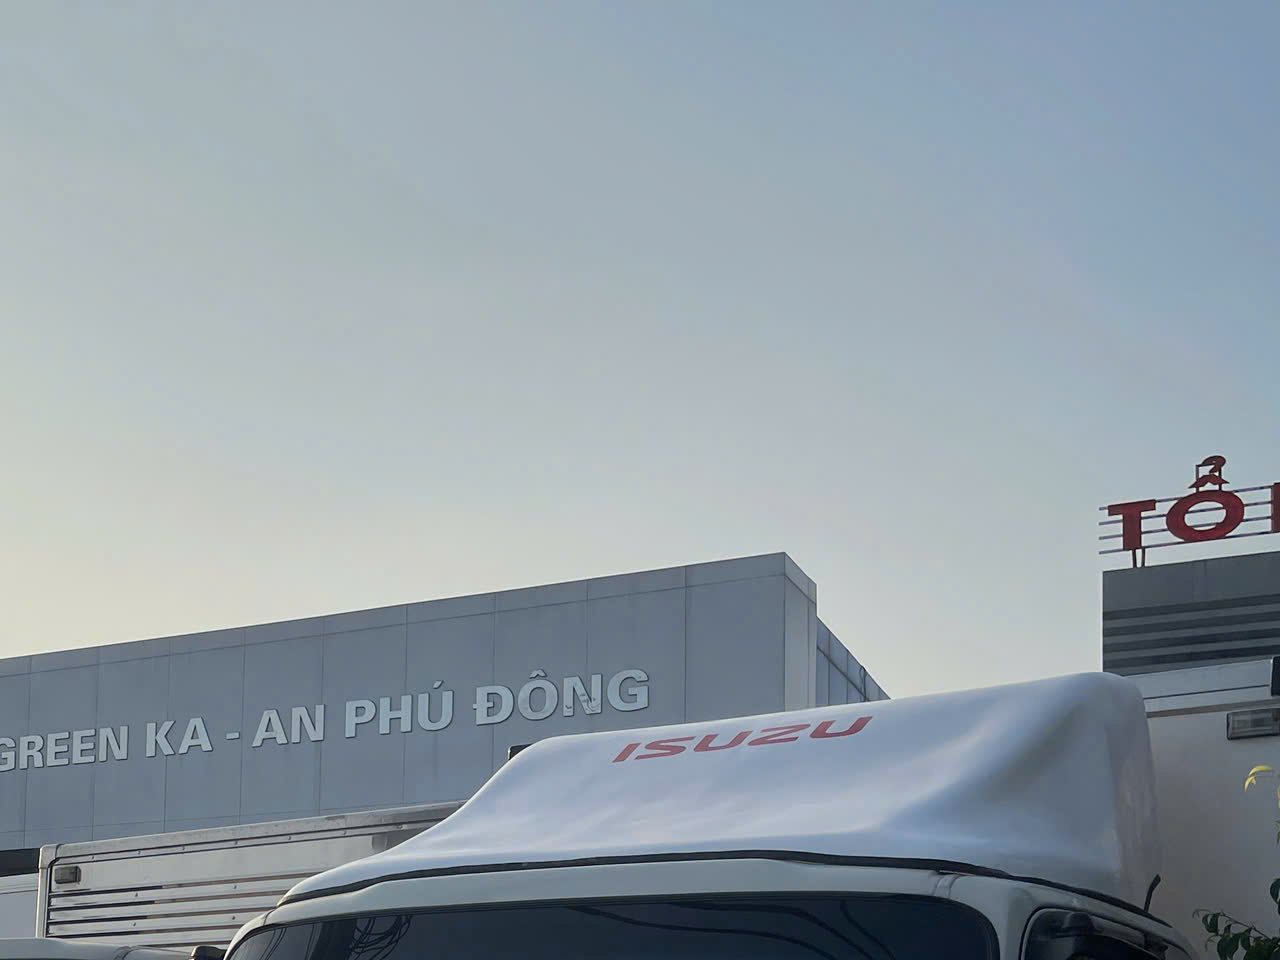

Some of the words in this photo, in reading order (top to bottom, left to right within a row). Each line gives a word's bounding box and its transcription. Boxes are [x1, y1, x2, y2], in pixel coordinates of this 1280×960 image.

[1107, 455, 1280, 550] TỔ
[145, 716, 213, 758] KA
[252, 704, 325, 748] AN
[344, 680, 454, 739] PHÚ
[472, 668, 650, 725] ĐÔNG
[612, 716, 873, 763] ISUZU
